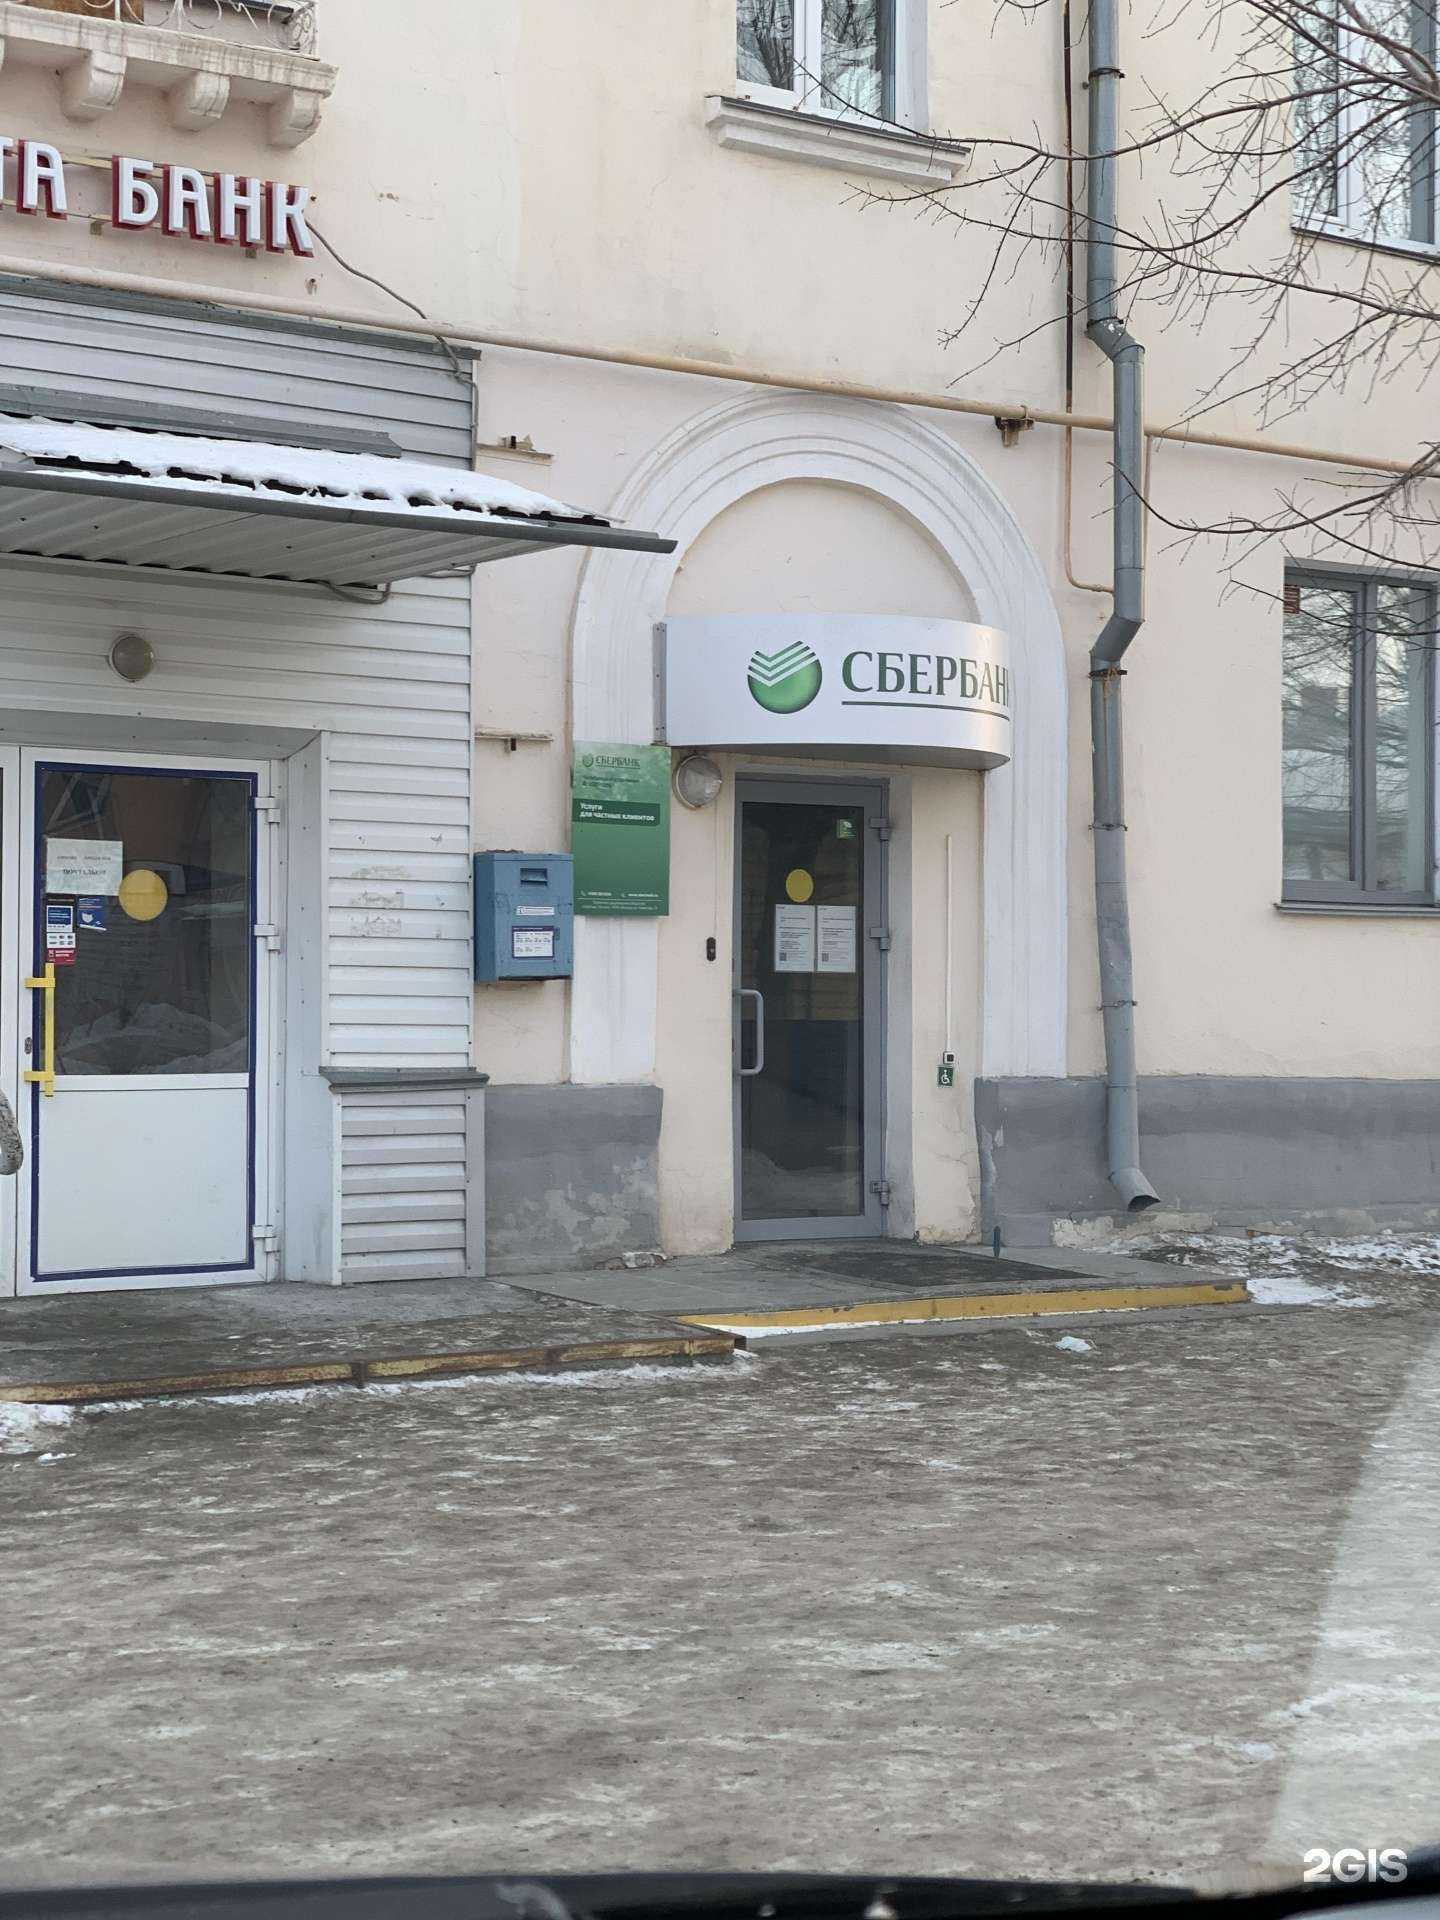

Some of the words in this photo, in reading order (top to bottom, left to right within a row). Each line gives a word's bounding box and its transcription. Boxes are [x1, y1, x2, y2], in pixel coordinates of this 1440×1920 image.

[111, 155, 313, 257] БАНК
[842, 651, 1009, 708] СБЕРБАН
[597, 755, 641, 767] СБЕРБАНК
[580, 803, 603, 811] Услуги
